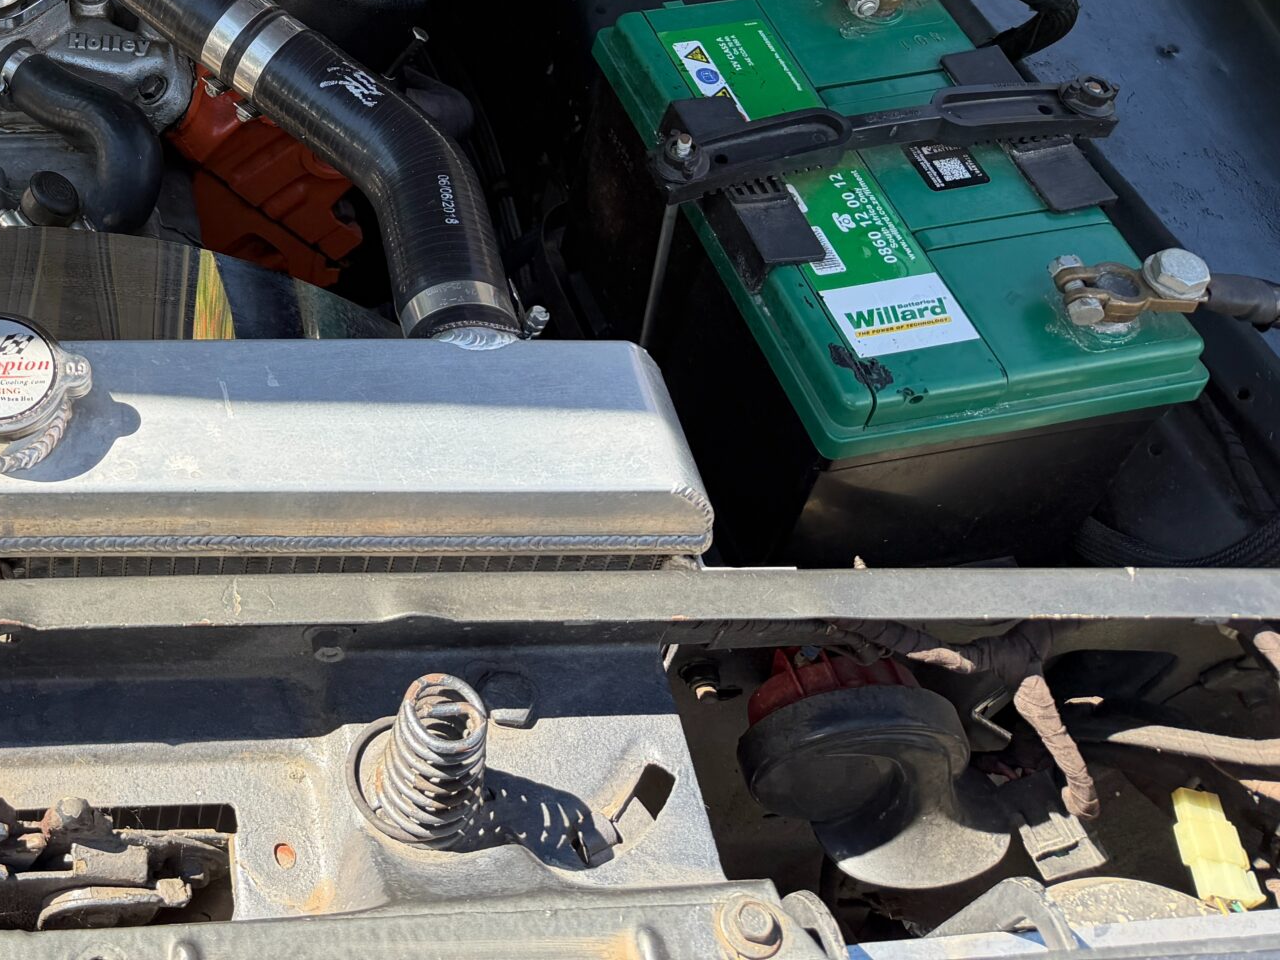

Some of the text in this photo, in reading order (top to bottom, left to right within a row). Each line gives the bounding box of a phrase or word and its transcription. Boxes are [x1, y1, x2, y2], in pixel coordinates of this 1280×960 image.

[68, 33, 150, 57] Holley
[719, 42, 735, 60] CLASS
[829, 173, 897, 263] 0860 12 00 12
[854, 187, 898, 249] South Africa Only
[844, 297, 947, 330] Willard
[872, 326, 894, 334] POWER
[906, 317, 948, 329] TECHNOLOGY
[64, 362, 87, 376] 0.9
